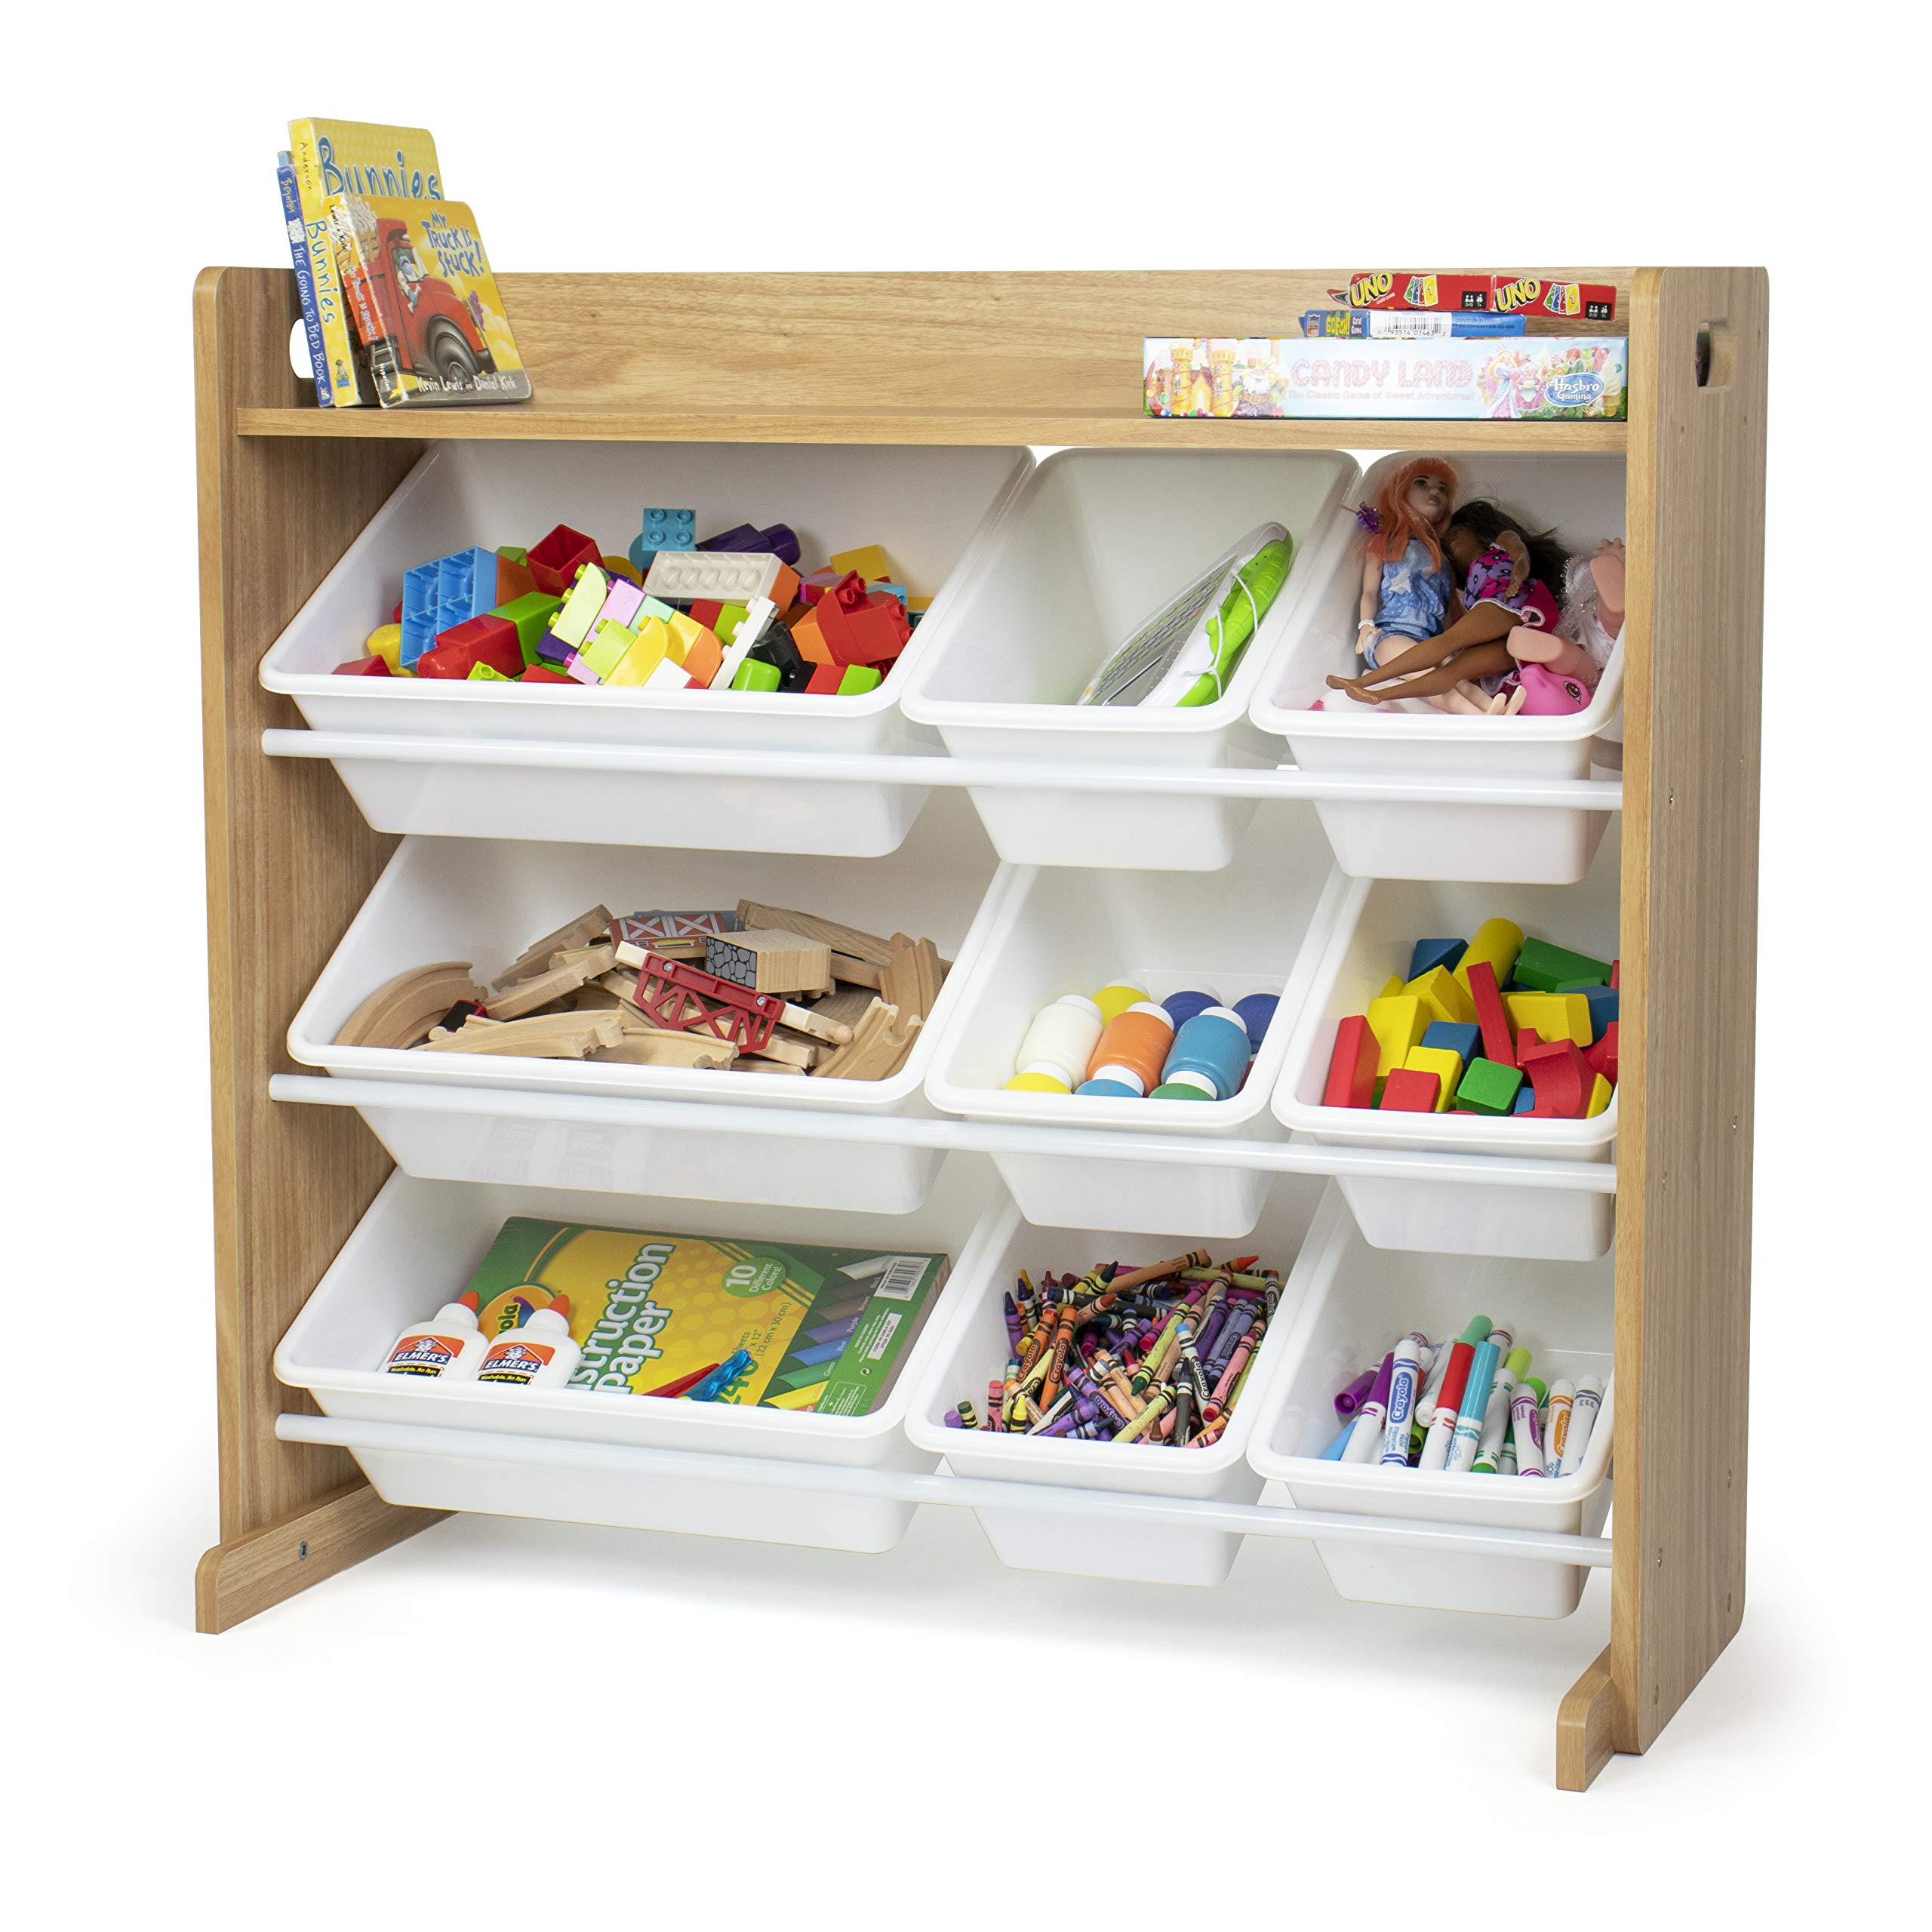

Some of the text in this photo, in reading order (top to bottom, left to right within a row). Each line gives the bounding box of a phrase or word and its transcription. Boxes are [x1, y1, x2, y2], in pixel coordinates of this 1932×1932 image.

[300, 142, 312, 191] Anderson
[318, 136, 441, 200] Bunnies
[305, 220, 338, 324] Bunnies
[1350, 272, 1393, 306] UNO
[1494, 278, 1540, 312] UNO
[293, 245, 326, 384] THE GOING TO BED BOOK
[415, 375, 440, 392] Kevin
[439, 375, 463, 391] Lewis
[472, 374, 499, 391] Daniel
[498, 375, 516, 390] Kirk
[1291, 359, 1473, 387] CANDY LAND
[1548, 377, 1600, 394] Hasbro
[1306, 390, 1341, 399] Classic
[1343, 391, 1371, 400] Game
[1373, 391, 1383, 399] of
[1385, 391, 1415, 400] Sweet
[1557, 389, 1592, 403] Gaming
[726, 1265, 758, 1287] 10
[749, 1263, 774, 1293] Different
[761, 1266, 783, 1291] Colors!
[755, 1345, 768, 1356] (22
[763, 1332, 774, 1343] cm
[774, 1316, 782, 1327] 30
[780, 1302, 792, 1316] cm)
[846, 1316, 860, 1333] Purple
[394, 1351, 448, 1363] ELMER'S
[594, 1301, 672, 1394] paper
[835, 1340, 848, 1352] Blue
[1017, 1343, 1037, 1381] Crayola
[485, 1359, 538, 1371] ELMER'S
[823, 1361, 836, 1377] Green
[1049, 1343, 1068, 1382] Crayola
[1194, 1361, 1211, 1399] Crayola
[1094, 1395, 1125, 1430] Crayola
[1392, 1377, 1409, 1420] Crayola
